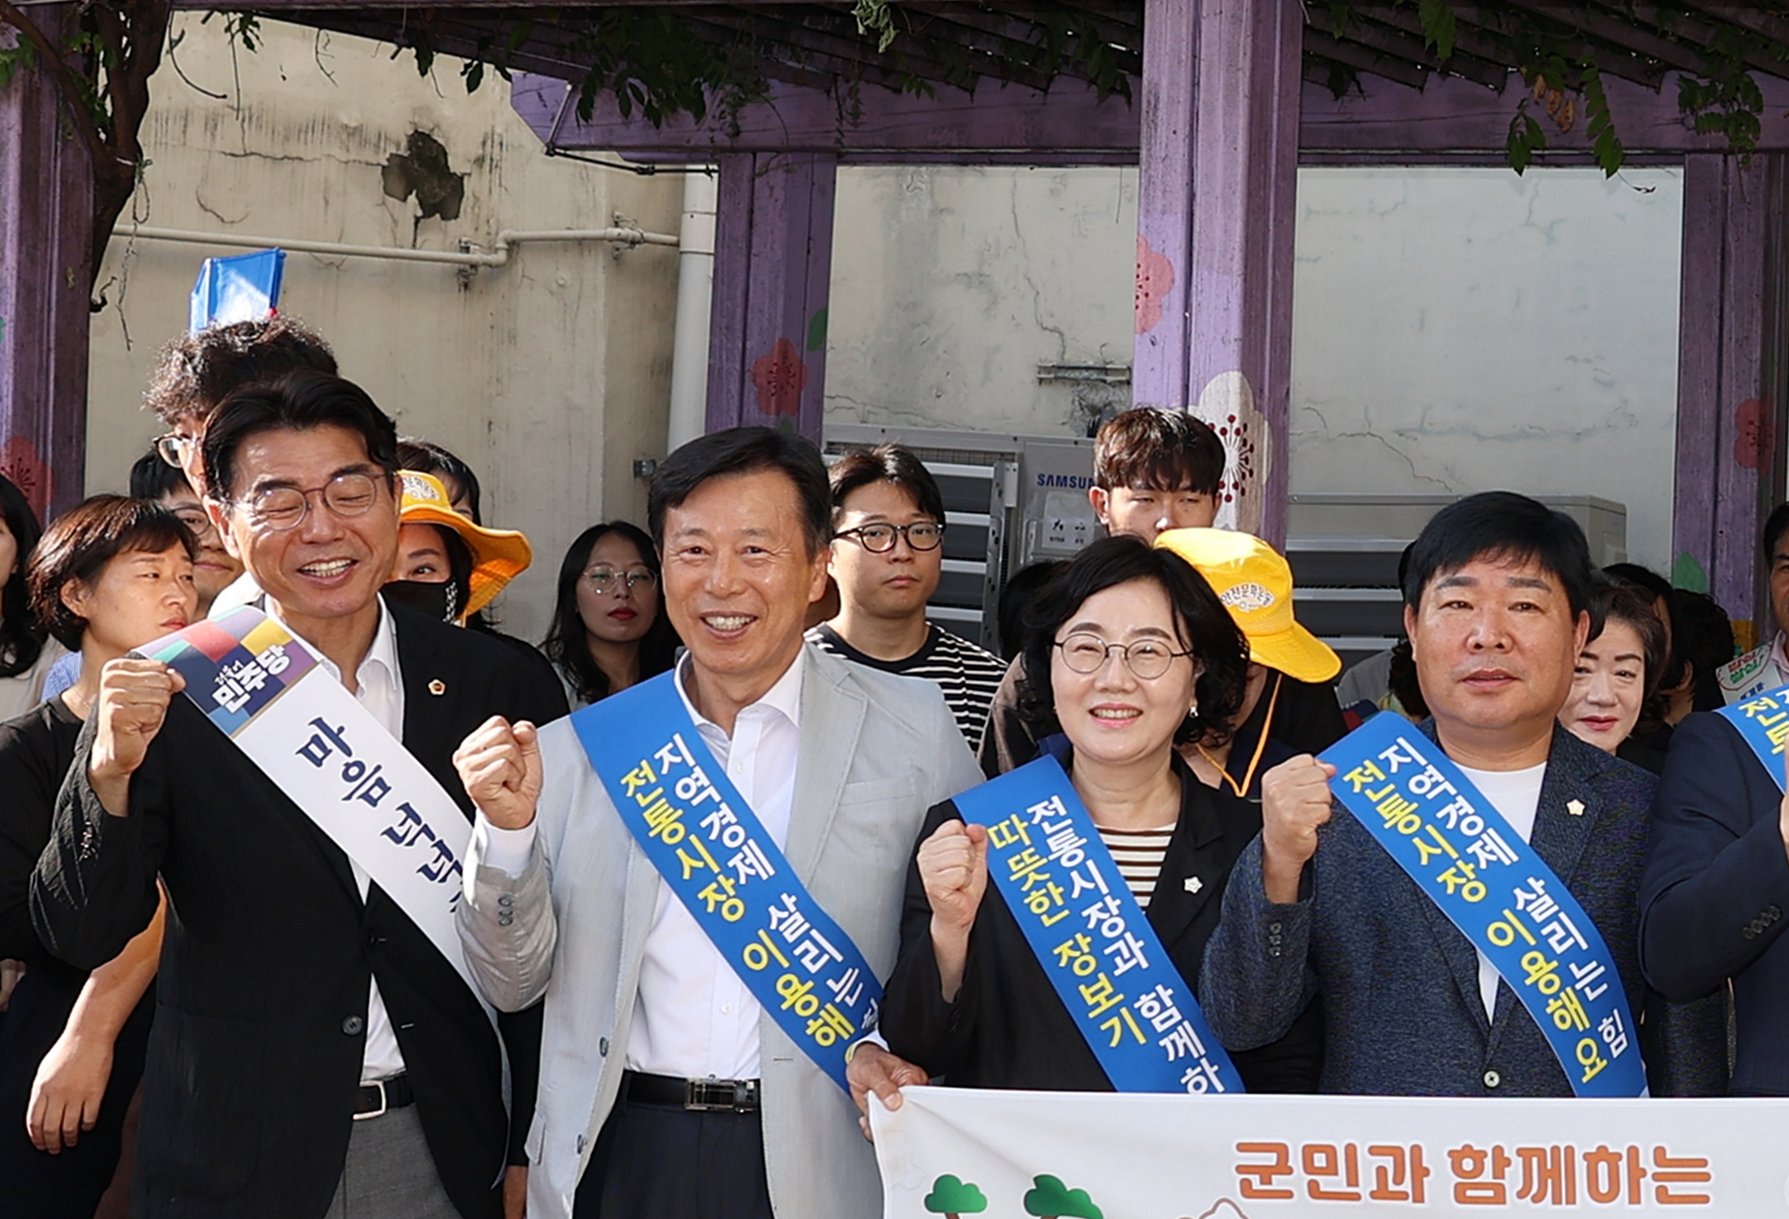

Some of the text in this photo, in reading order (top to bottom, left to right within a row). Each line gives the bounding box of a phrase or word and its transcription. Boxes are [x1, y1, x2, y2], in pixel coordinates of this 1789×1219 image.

[211, 644, 292, 713] 민주당
[295, 717, 463, 912] 마음 넉넉
[620, 760, 858, 1064] 전통시장 이용해
[655, 733, 863, 1007] 지역경제 살리는
[986, 813, 1148, 1048] 따뜻한 장보기
[1026, 795, 1149, 977] 전통시장과
[1343, 759, 1609, 1084] 전통시장 이용해요
[1378, 736, 1629, 1059] 지역경제 살리는 힘
[1234, 1141, 1711, 1207] 군민과 함께하는
